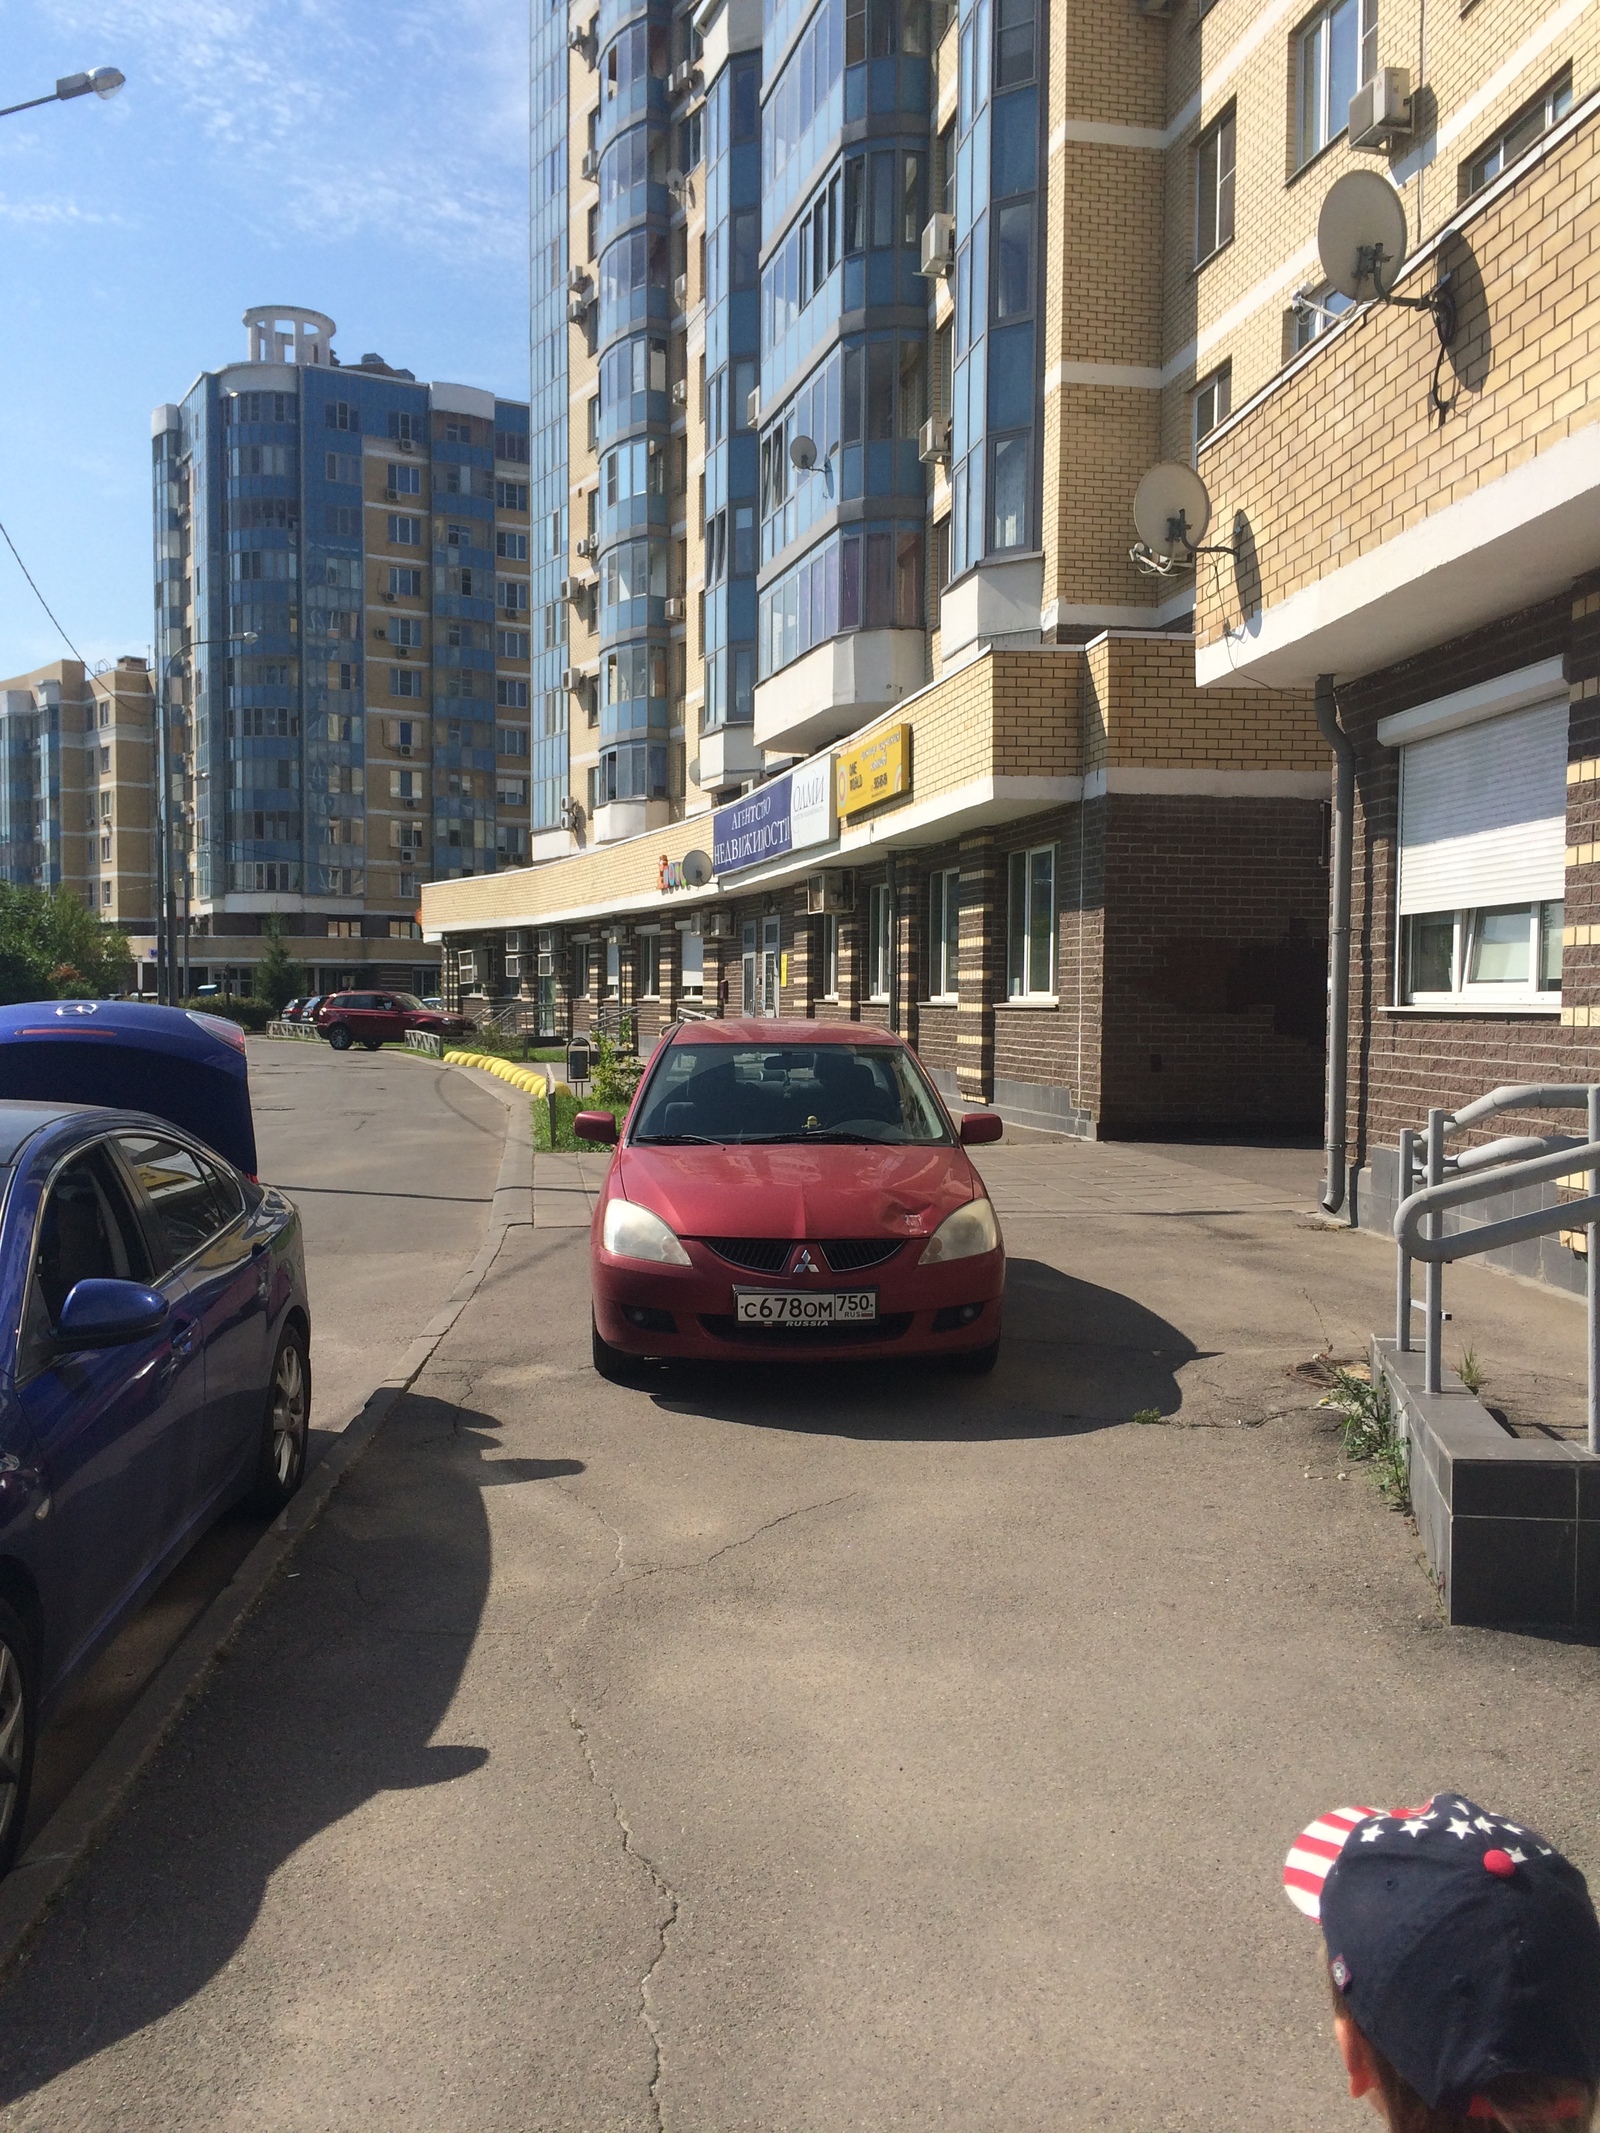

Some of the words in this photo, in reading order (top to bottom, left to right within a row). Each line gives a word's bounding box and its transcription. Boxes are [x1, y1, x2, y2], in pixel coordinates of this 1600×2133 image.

[731, 796, 771, 830] АГЕНТСТВО
[714, 816, 790, 866] НЕДВИЖИМОСТИ
[836, 1295, 870, 1312] 750
